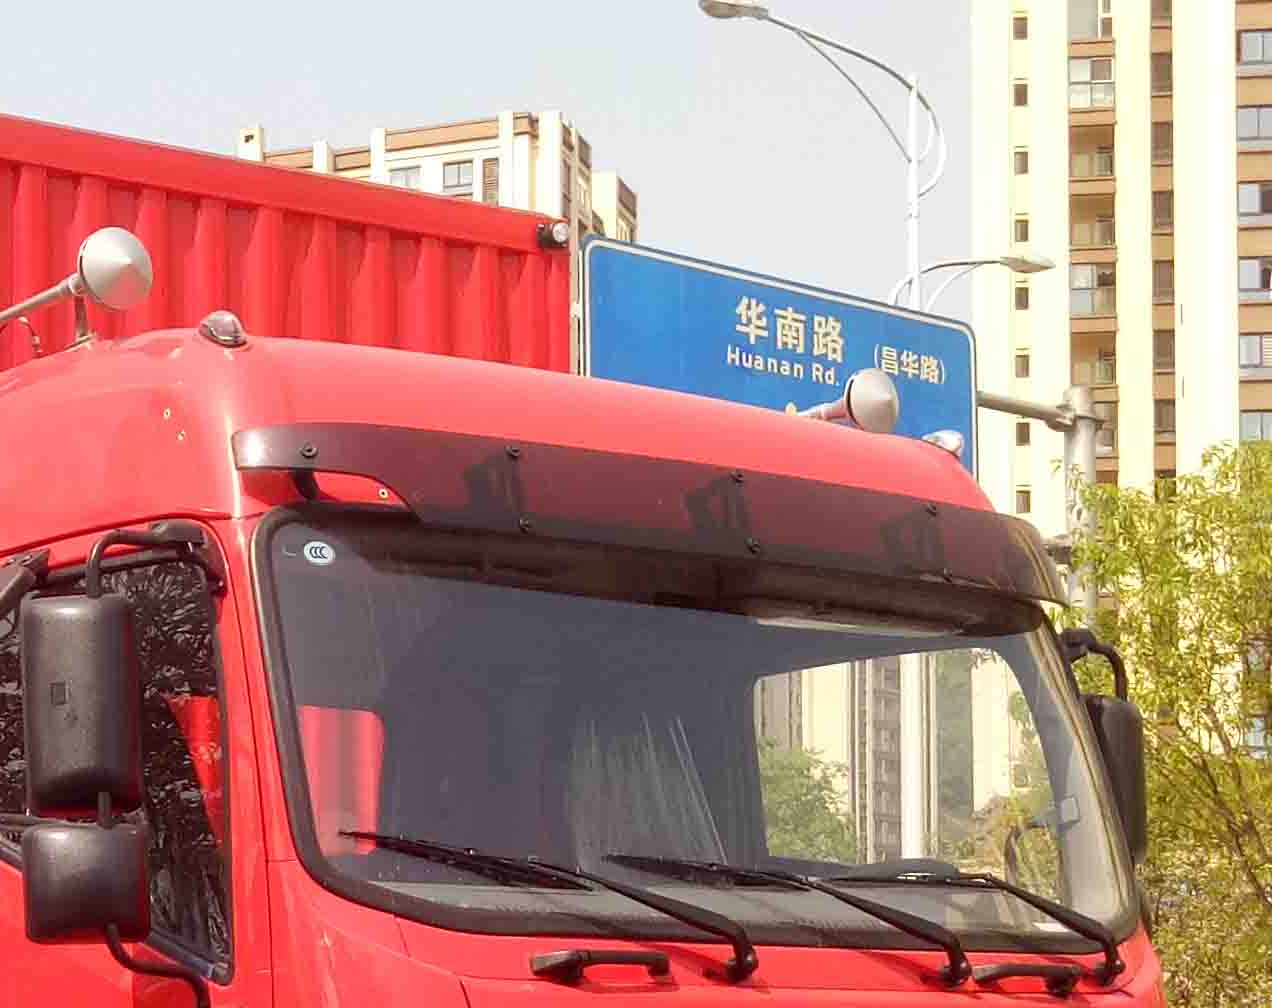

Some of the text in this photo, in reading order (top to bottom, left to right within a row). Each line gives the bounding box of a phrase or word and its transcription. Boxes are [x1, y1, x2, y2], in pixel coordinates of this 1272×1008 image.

[736, 296, 844, 362] 华南路
[727, 344, 840, 386] Huanan Rd.
